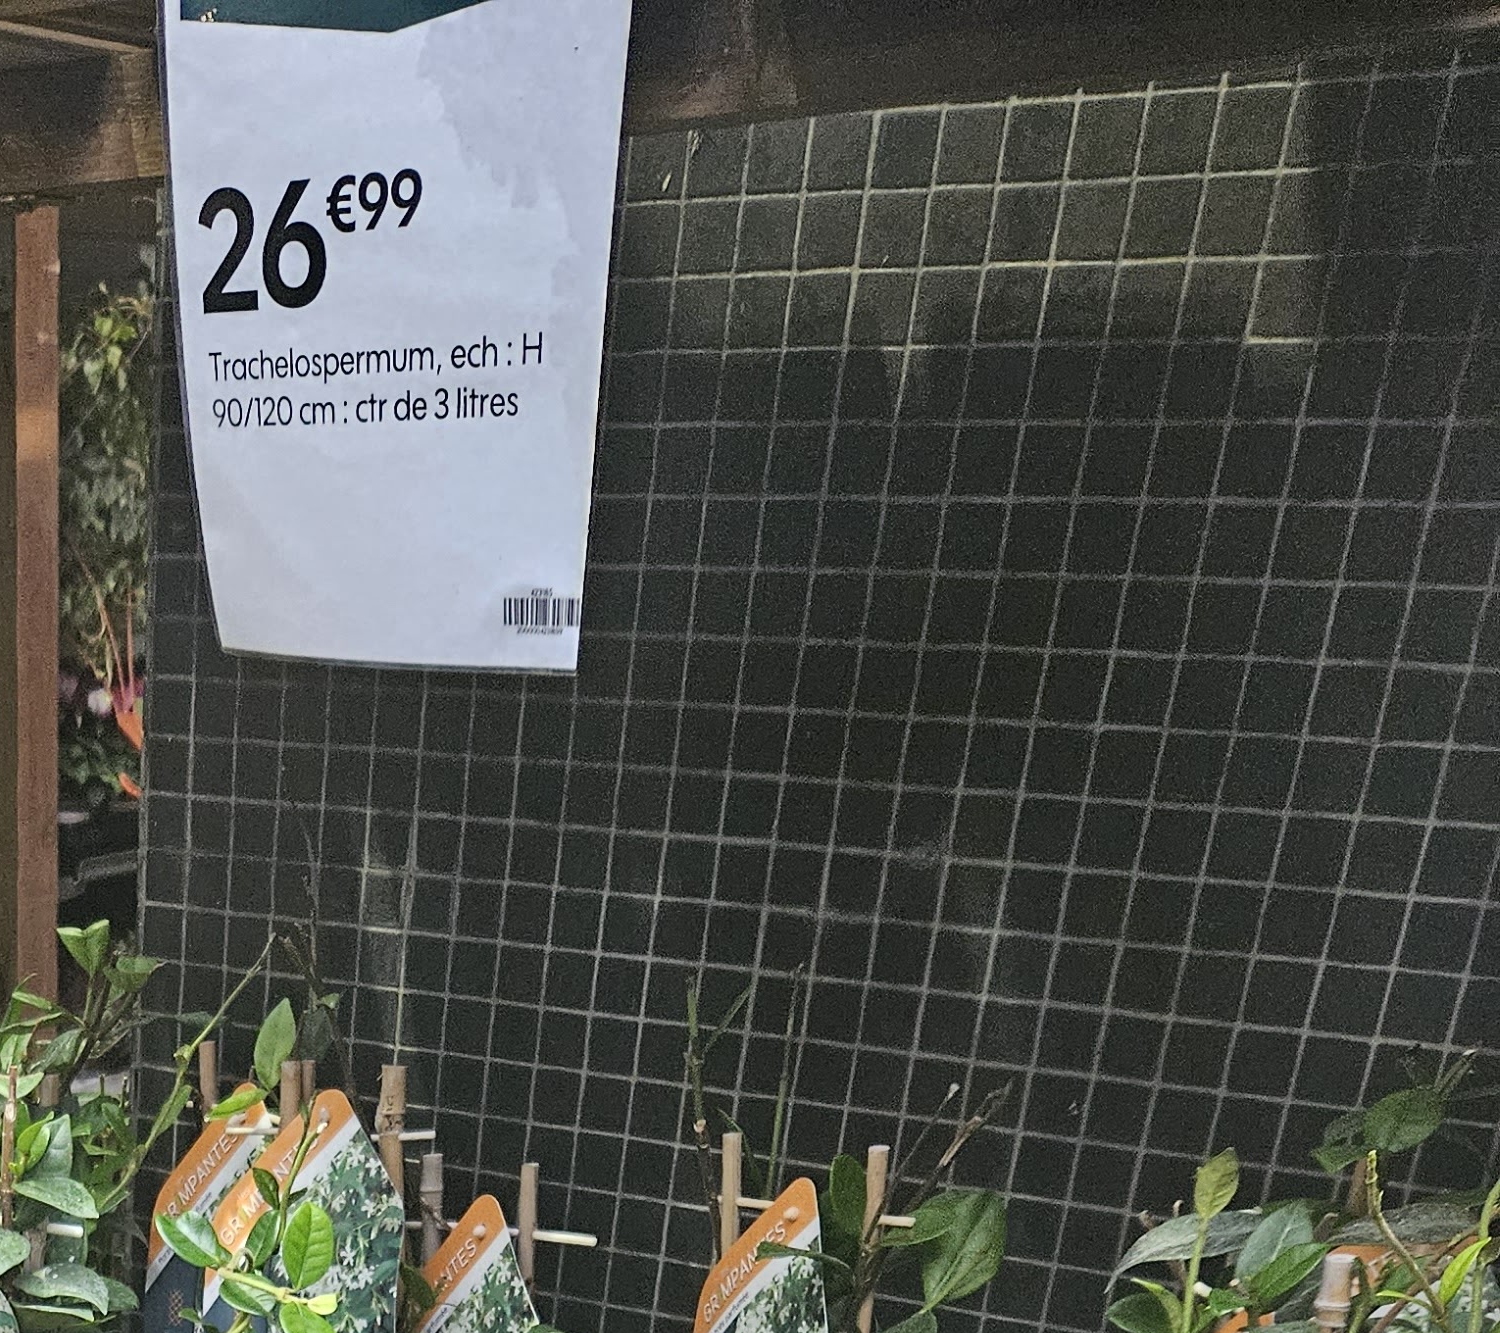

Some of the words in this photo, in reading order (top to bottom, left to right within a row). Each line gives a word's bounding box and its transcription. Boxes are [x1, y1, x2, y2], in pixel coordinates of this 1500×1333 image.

[208, 348, 443, 386] Trachelospermum,
[450, 338, 498, 368] ech
[521, 332, 544, 366] H
[212, 395, 292, 429] 90/120
[298, 403, 335, 426] cm
[356, 392, 389, 423] ctr
[392, 389, 427, 421] de
[434, 388, 451, 420] 3
[455, 386, 518, 419] litres
